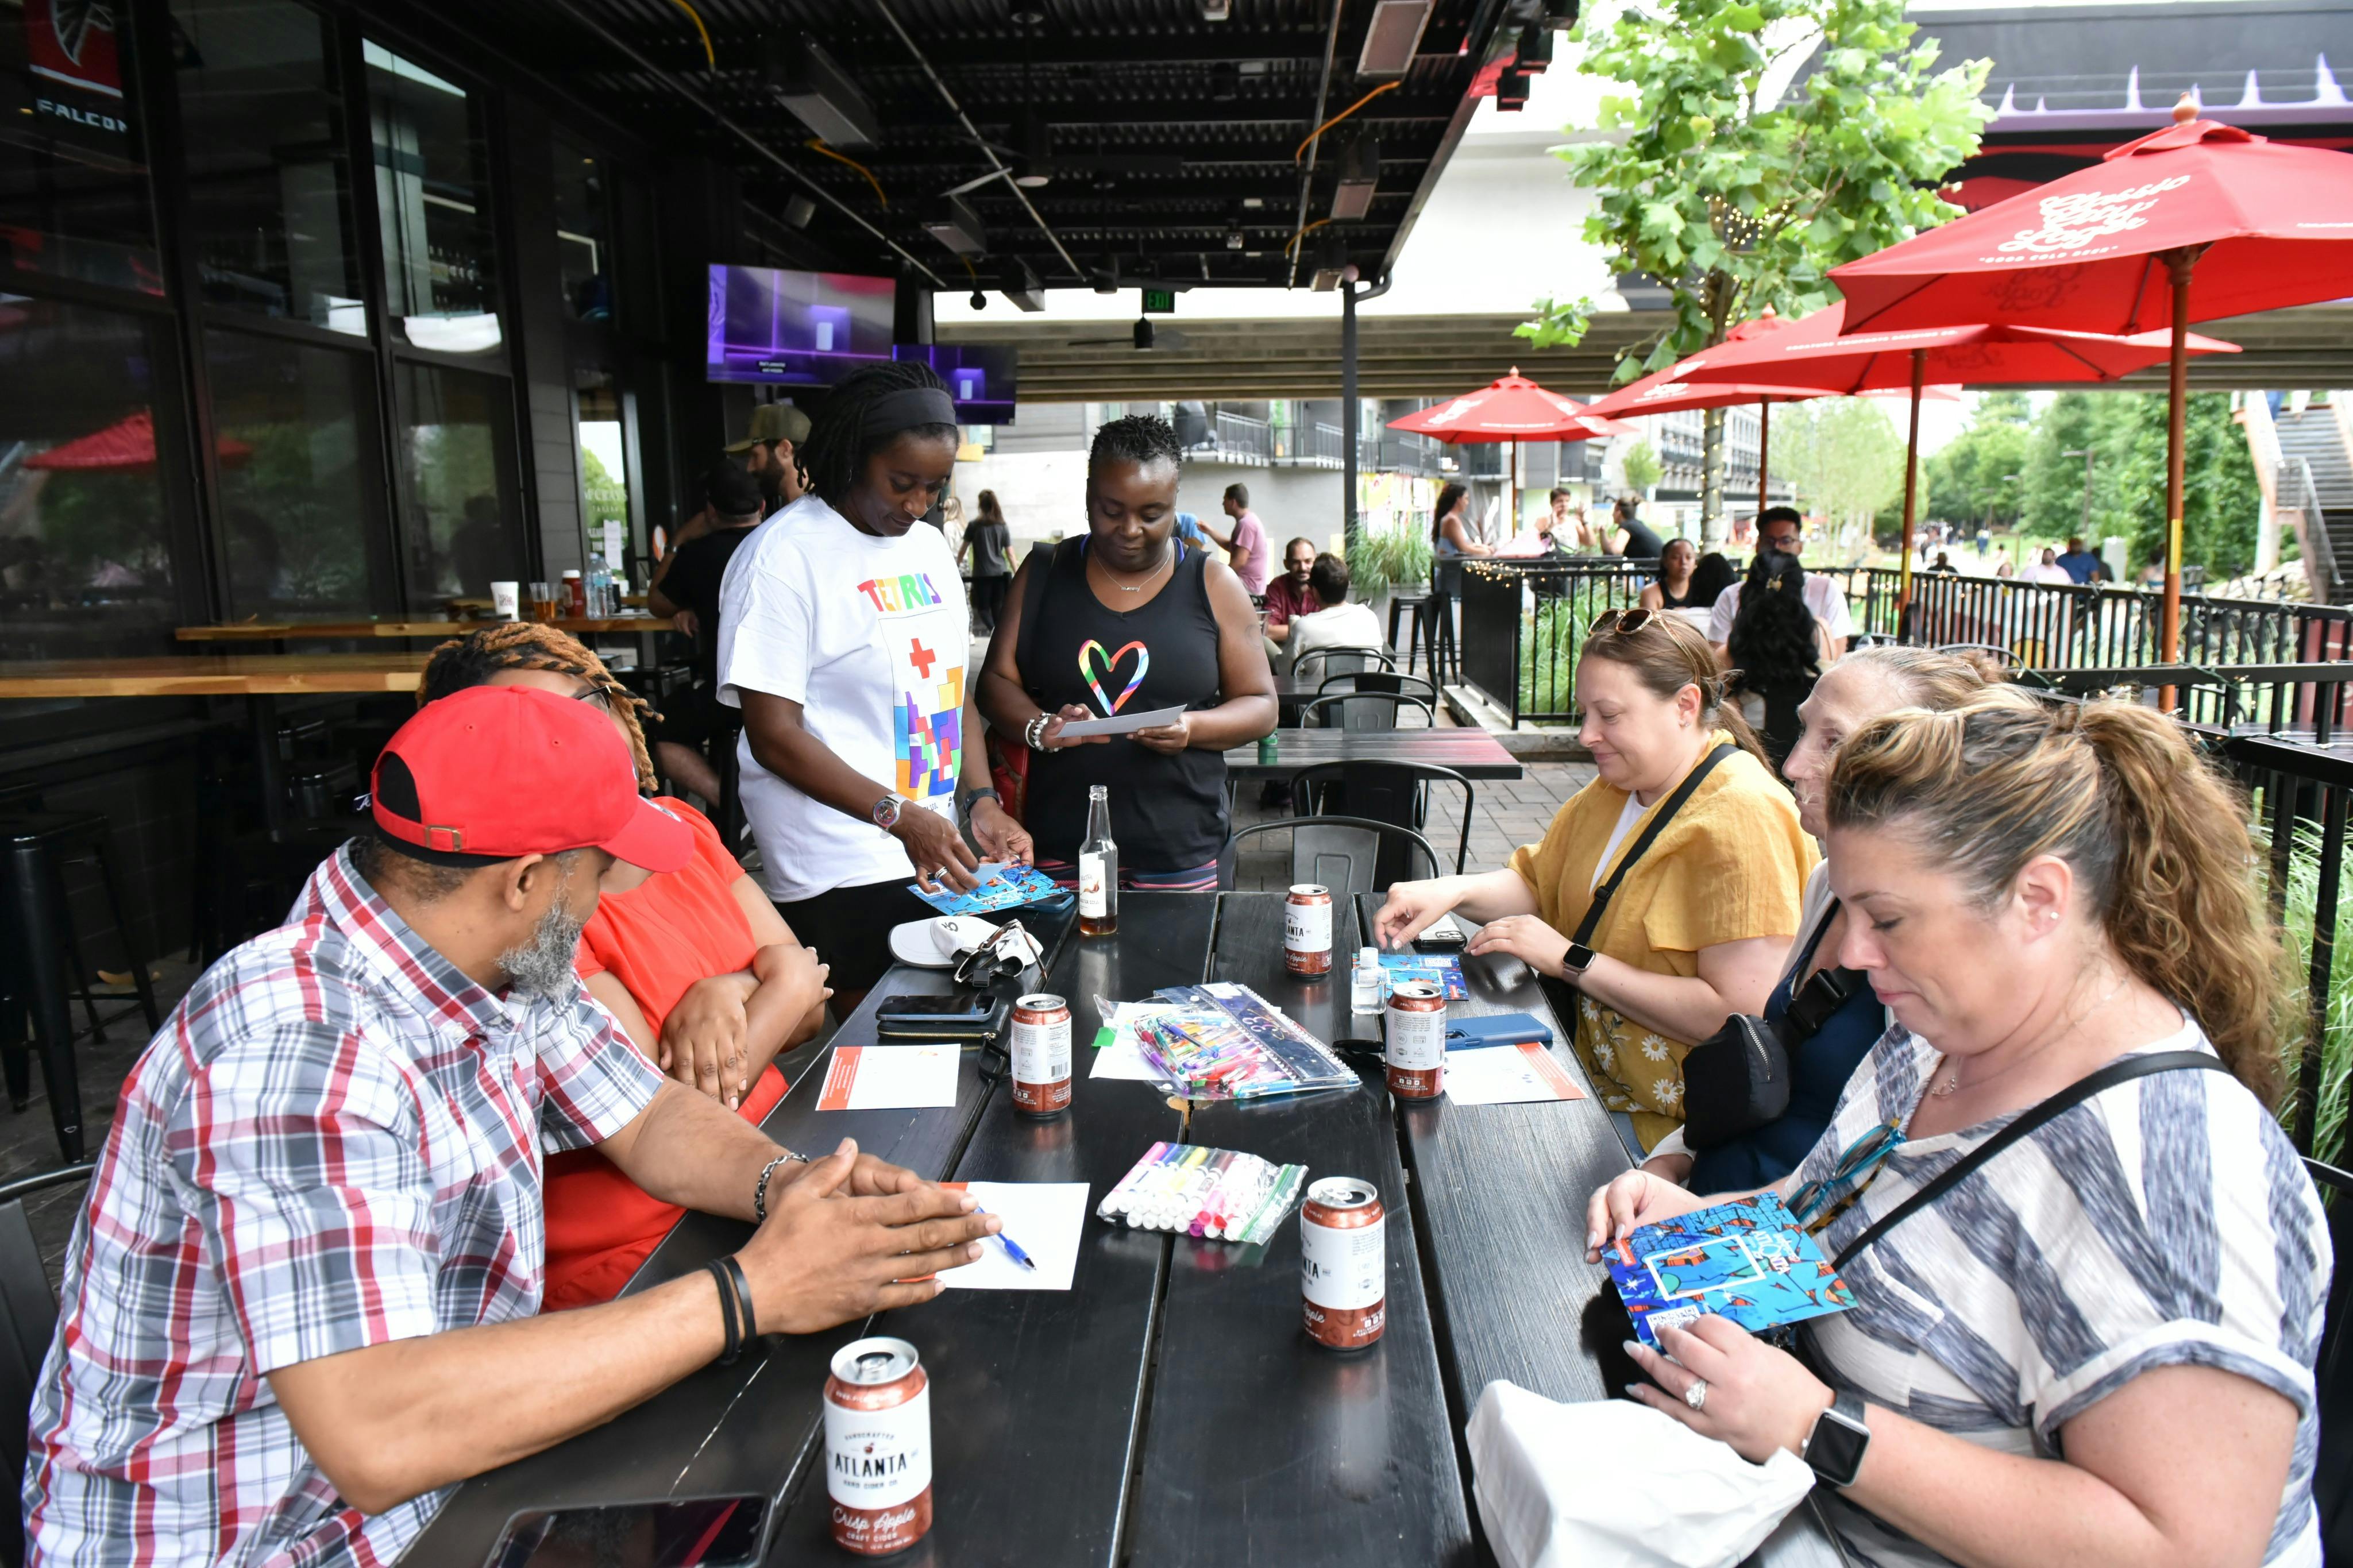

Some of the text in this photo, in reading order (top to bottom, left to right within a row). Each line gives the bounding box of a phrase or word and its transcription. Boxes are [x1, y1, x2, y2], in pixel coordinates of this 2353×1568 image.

[1148, 292, 1169, 309] EXIT
[857, 572, 942, 612] TETRIS
[835, 1453, 907, 1478] ATLANTA
[843, 1480, 860, 1489] HARD
[833, 1505, 916, 1533] Crisp Apple
[846, 1532, 898, 1542] CRAFT CIDER
